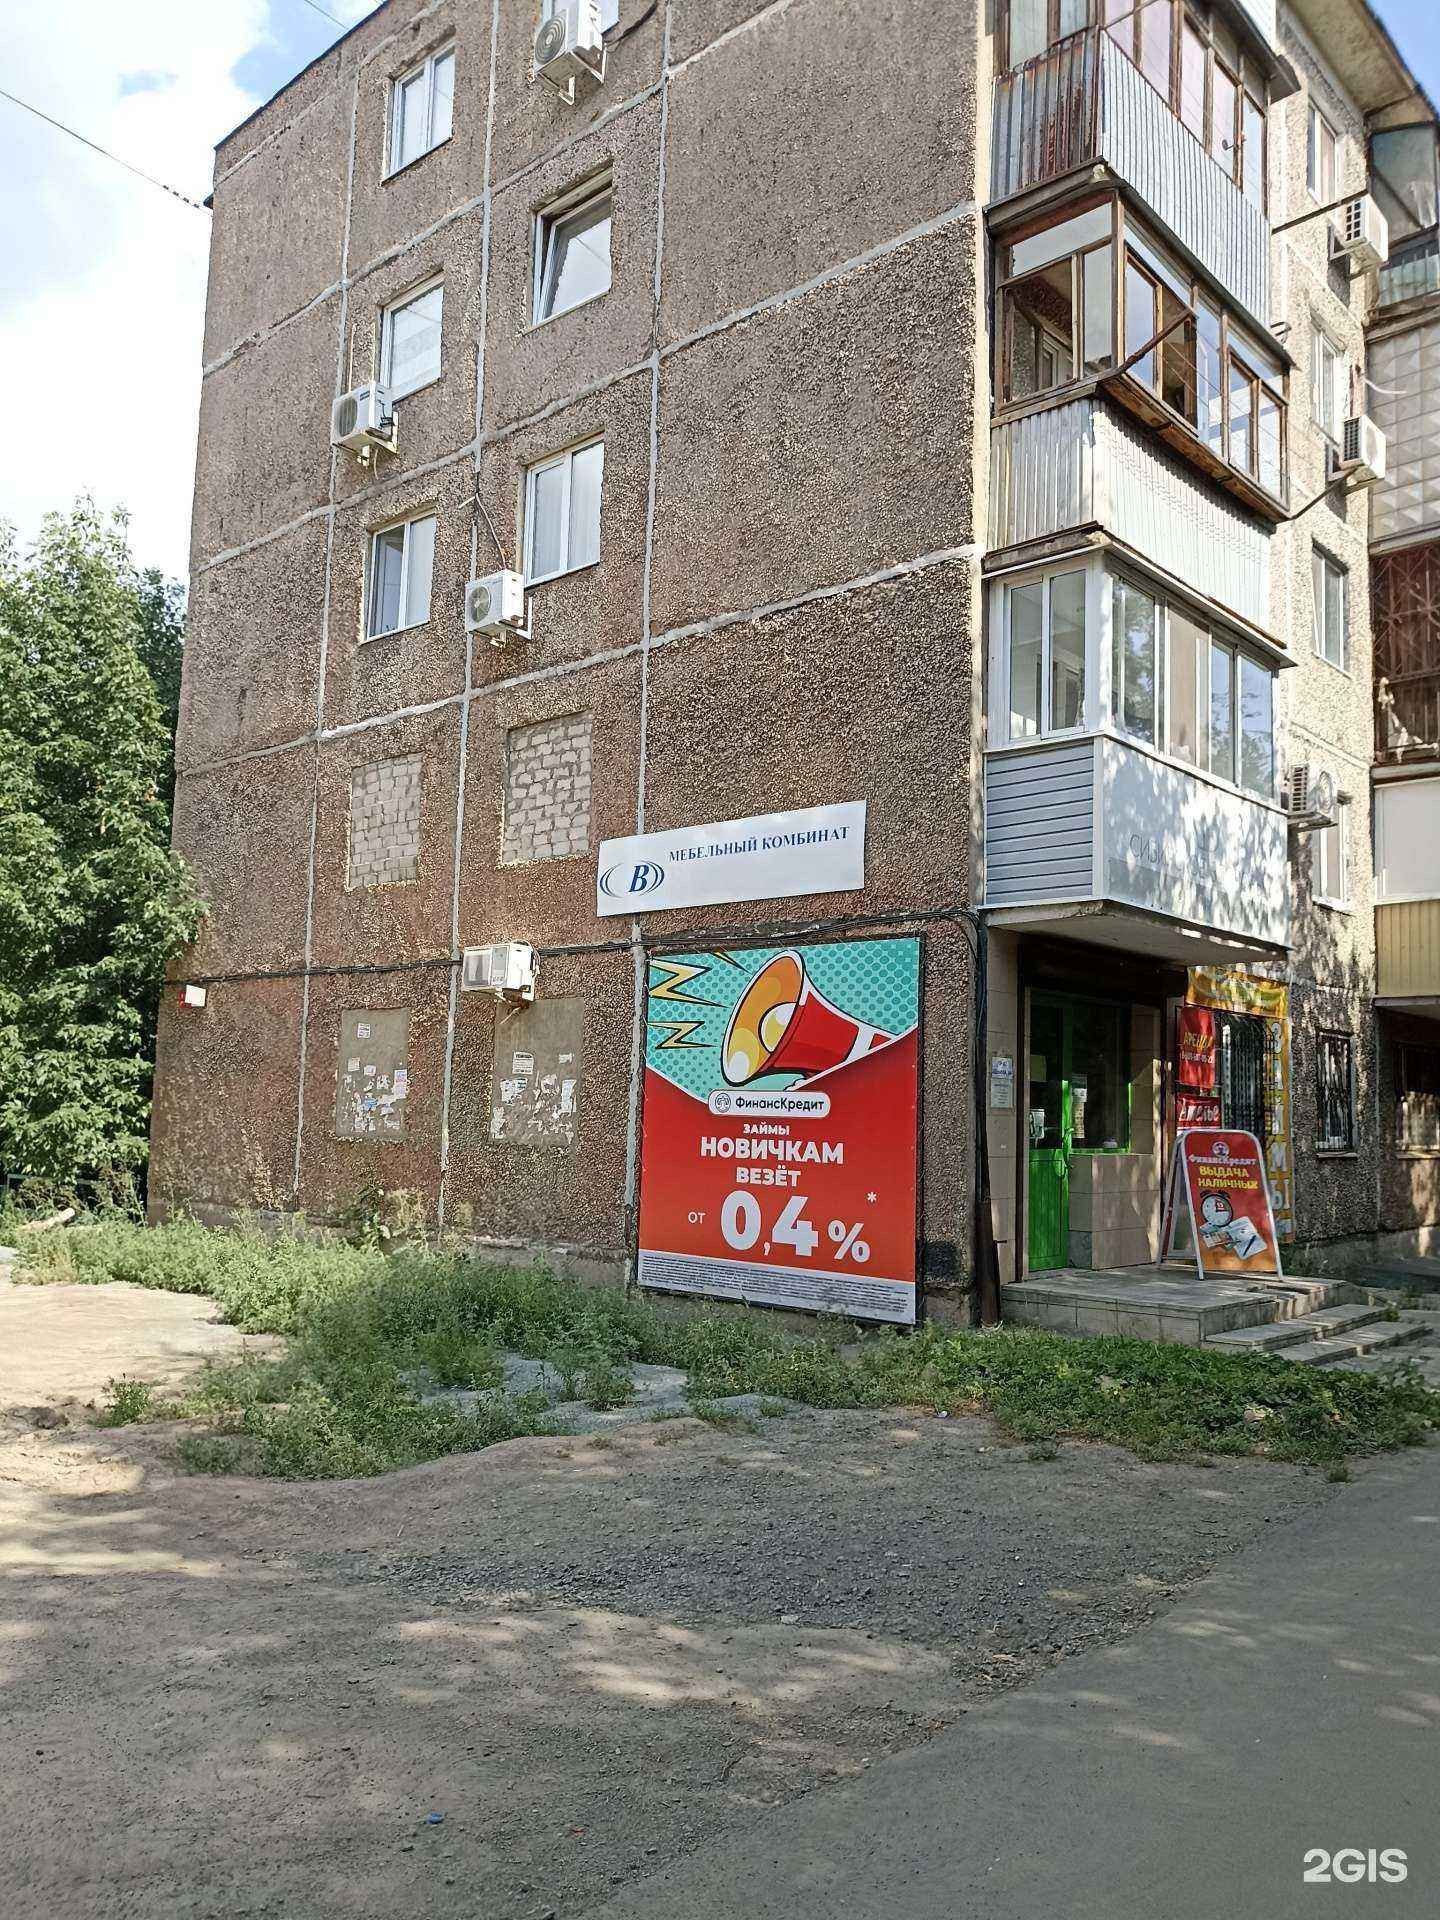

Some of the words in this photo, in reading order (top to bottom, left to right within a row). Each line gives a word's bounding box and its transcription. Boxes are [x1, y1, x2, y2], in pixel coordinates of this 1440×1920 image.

[669, 837, 757, 862] МЕБЕЛЬНЫЙ
[762, 826, 850, 849] КОМБИНАТ
[735, 1096, 825, 1112] ФинансКредит
[743, 1121, 790, 1136] ЗАЙМЫ
[700, 1136, 844, 1165] НОВИЧКАМ
[735, 1164, 802, 1188] ВЕЗЁТ
[1199, 1165, 1250, 1178] ВЫДАЧА
[1198, 1178, 1259, 1190] НАЛИЧНЫХ
